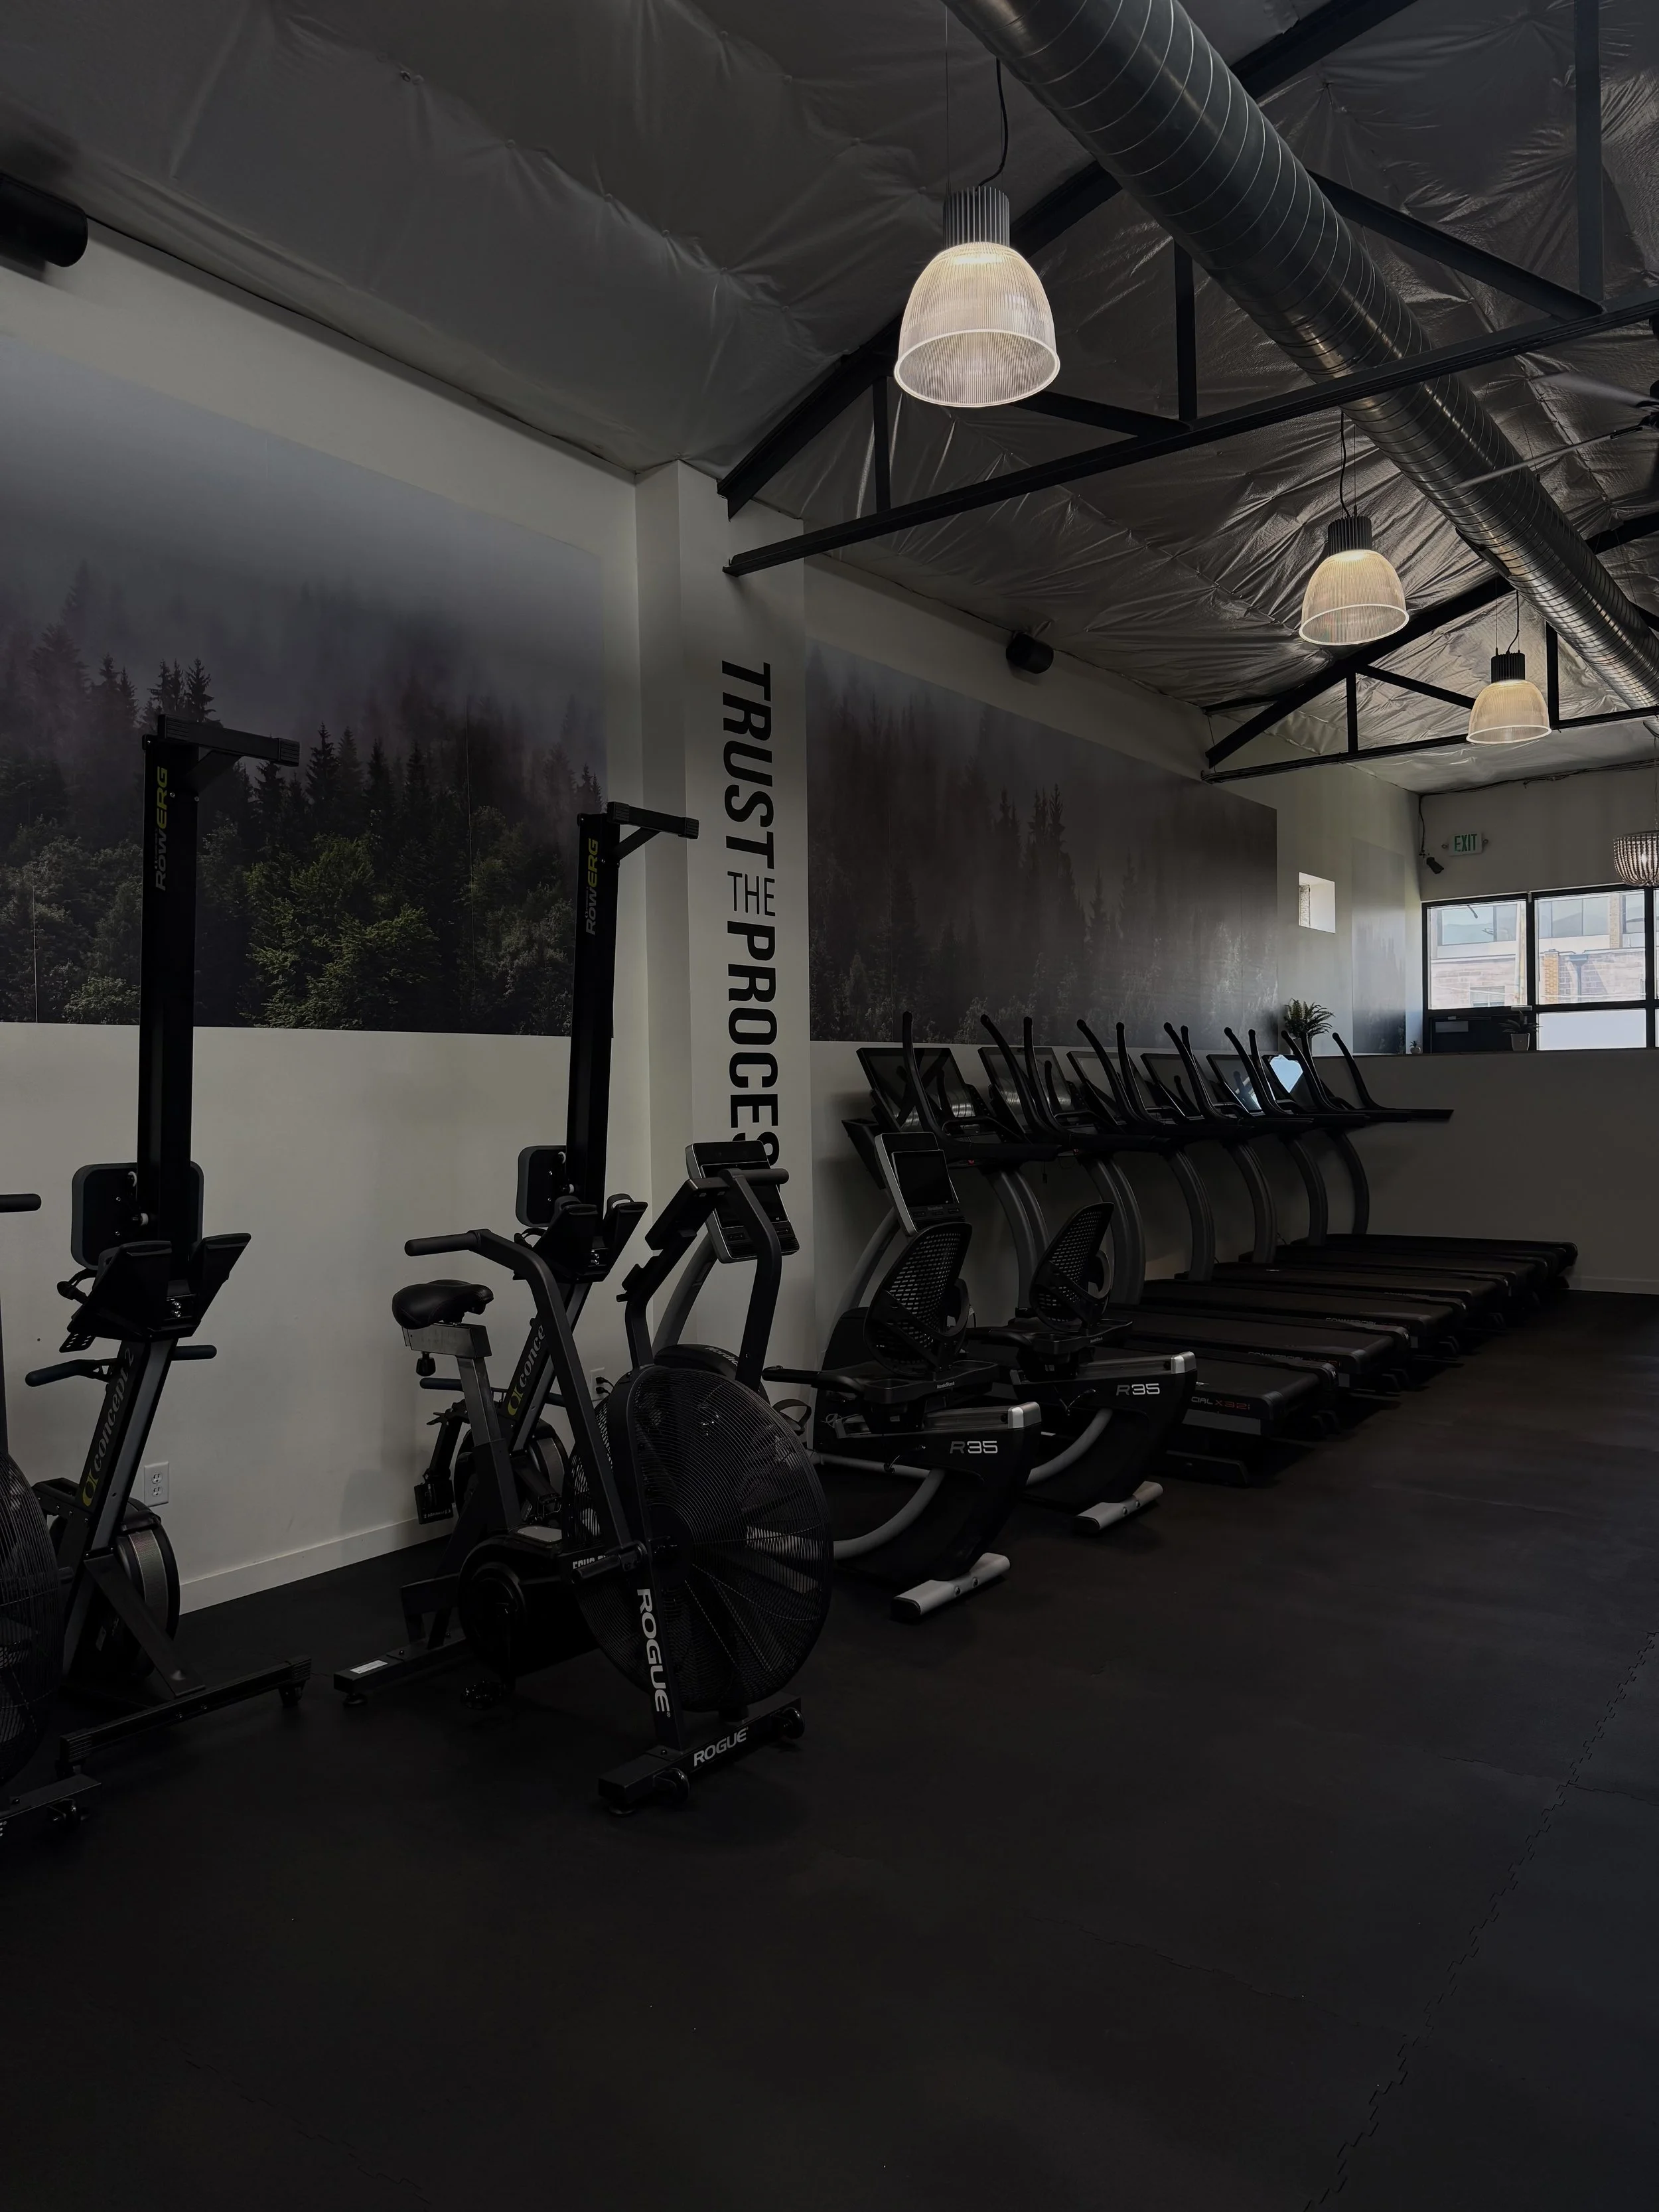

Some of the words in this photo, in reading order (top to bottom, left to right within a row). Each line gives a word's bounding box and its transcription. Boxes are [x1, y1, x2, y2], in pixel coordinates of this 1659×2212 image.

[721, 660, 774, 869] TRUST
[1453, 833, 1478, 852] EXIT
[727, 871, 776, 917] THE
[727, 921, 780, 1167] PROCES
[519, 1324, 545, 1388] conce
[704, 1347, 739, 1367] Nordic
[1116, 1382, 1161, 1396] R35
[1190, 1396, 1214, 1405] CIAL
[94, 1366, 129, 1472] concept
[124, 1347, 135, 1367] 2
[949, 1440, 999, 1454] R35
